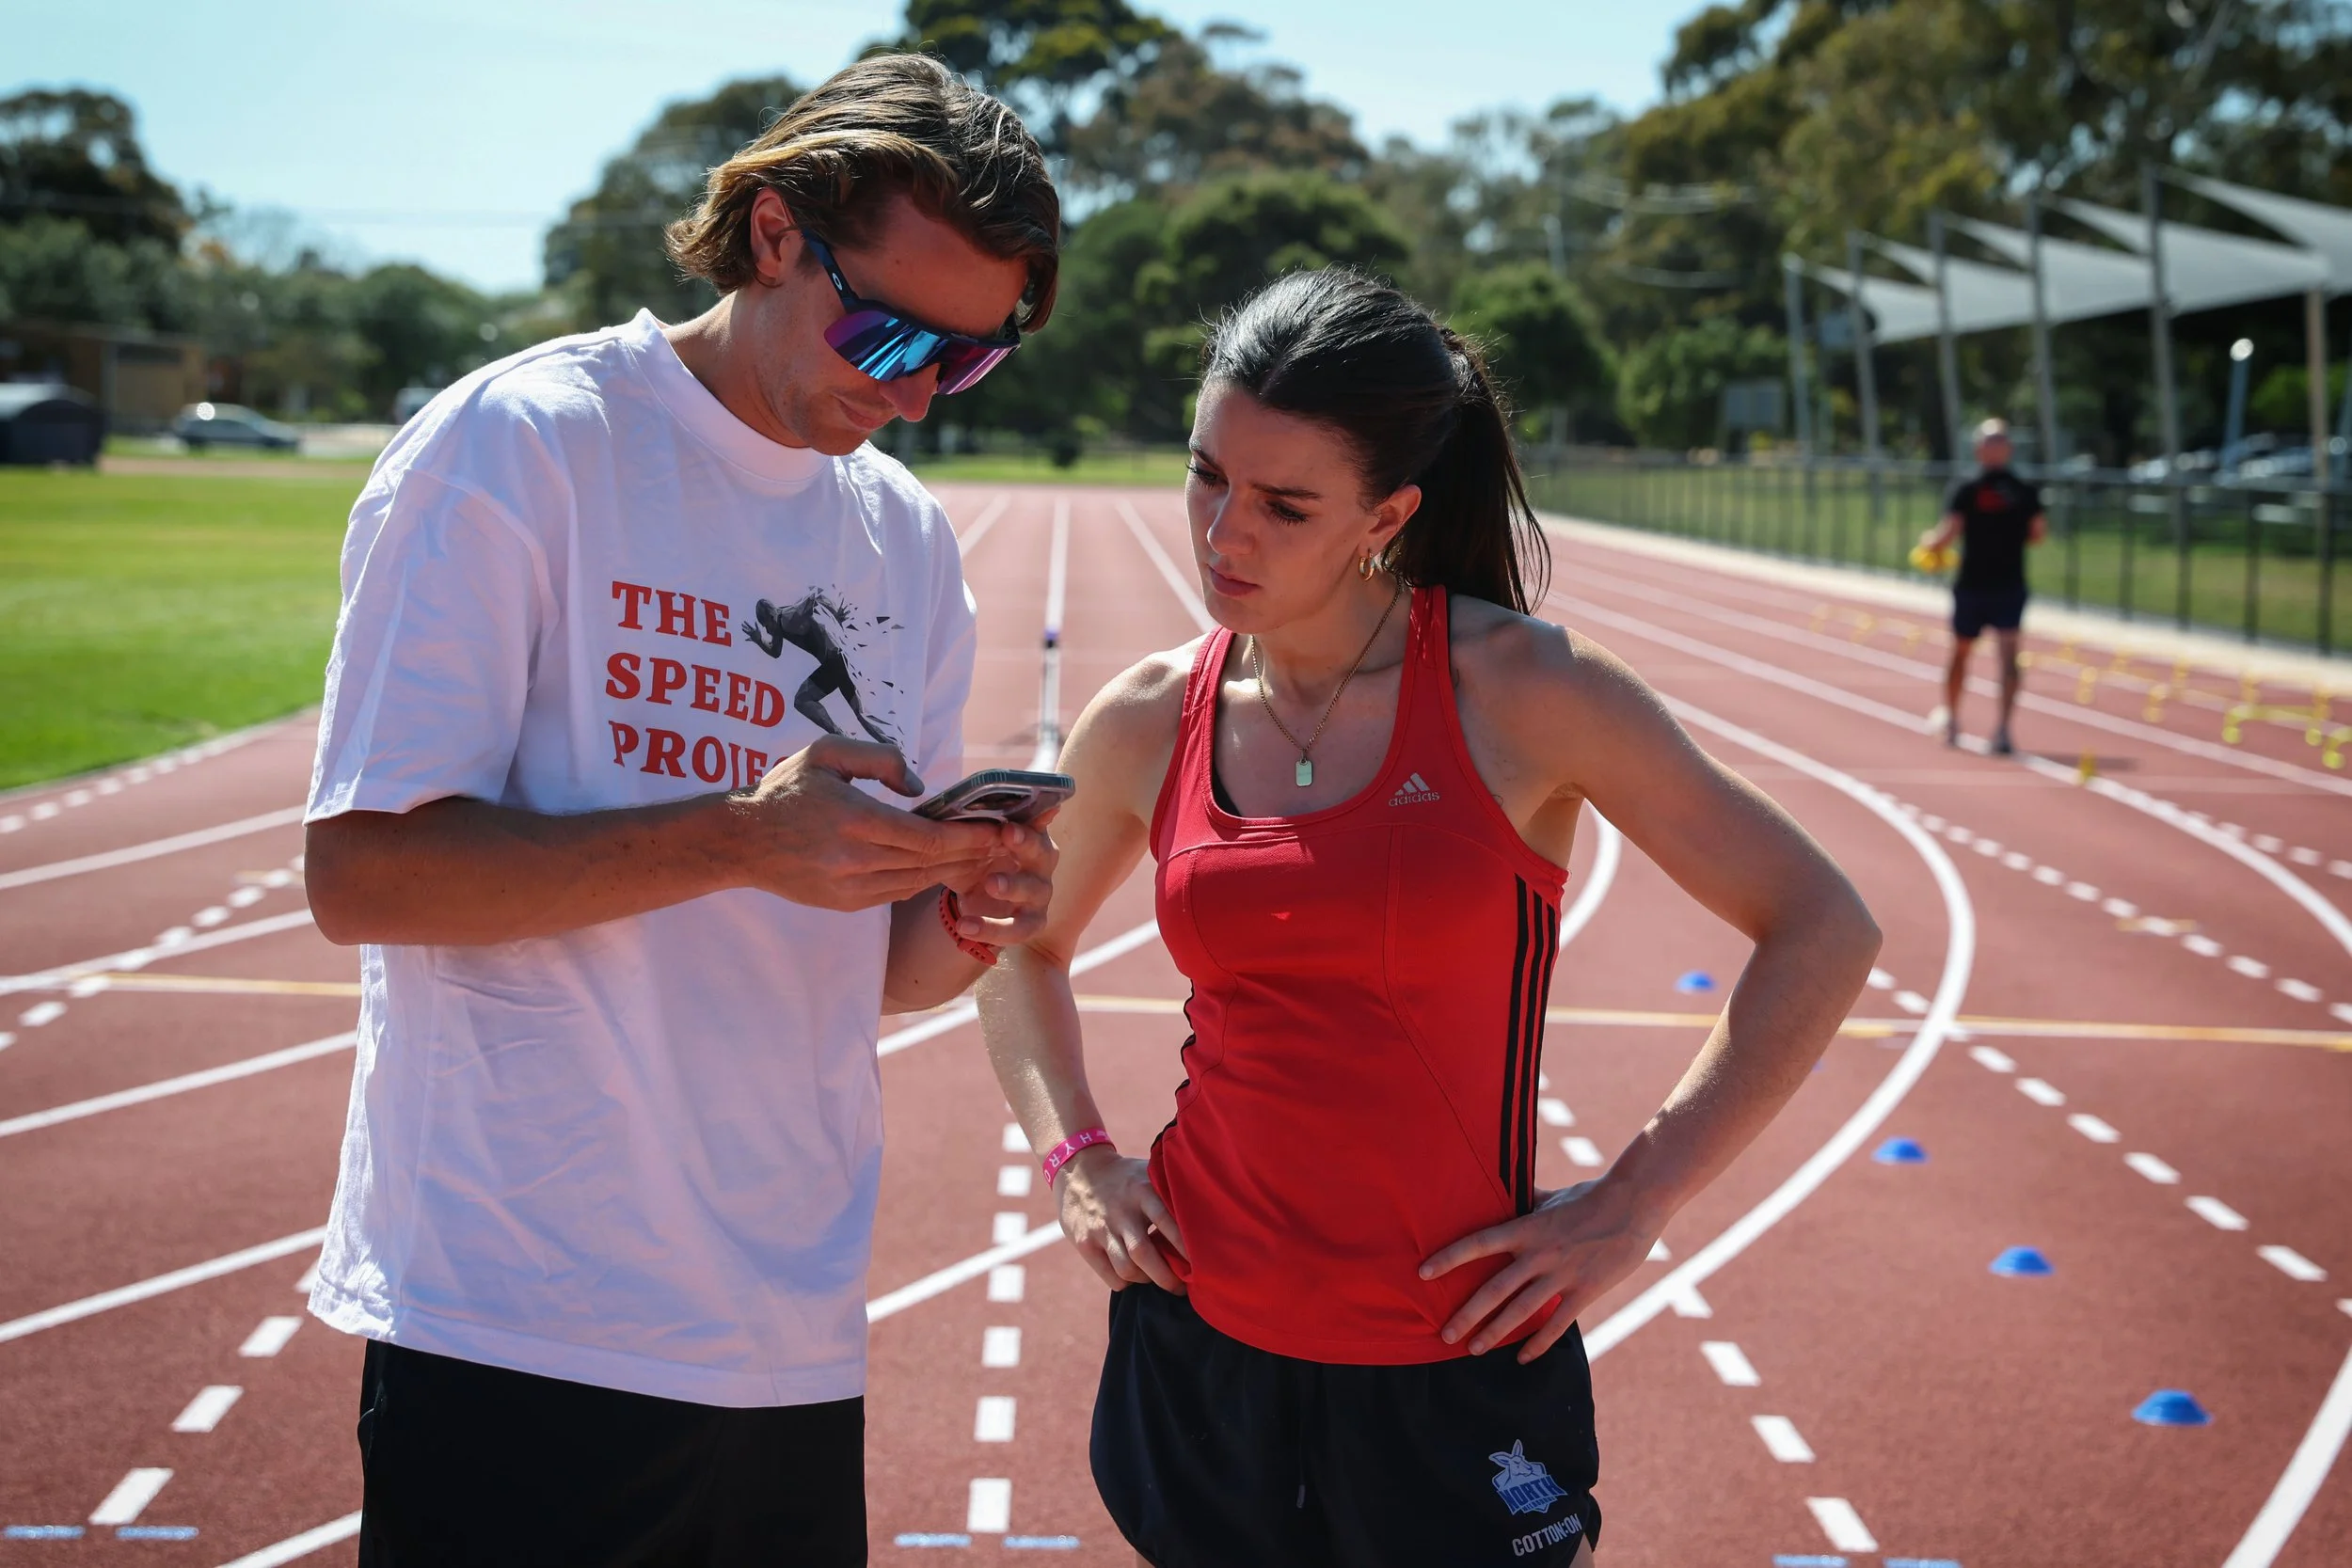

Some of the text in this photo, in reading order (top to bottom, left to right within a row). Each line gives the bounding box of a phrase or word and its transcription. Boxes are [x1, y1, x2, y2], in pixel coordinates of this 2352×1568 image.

[612, 580, 732, 647] THE
[605, 652, 785, 728] SPEED
[609, 721, 788, 789] PROJE
[1389, 792, 1440, 806] adidas
[1497, 1475, 1567, 1514] NORTH
[1512, 1513, 1582, 1557] COTTON:ON
